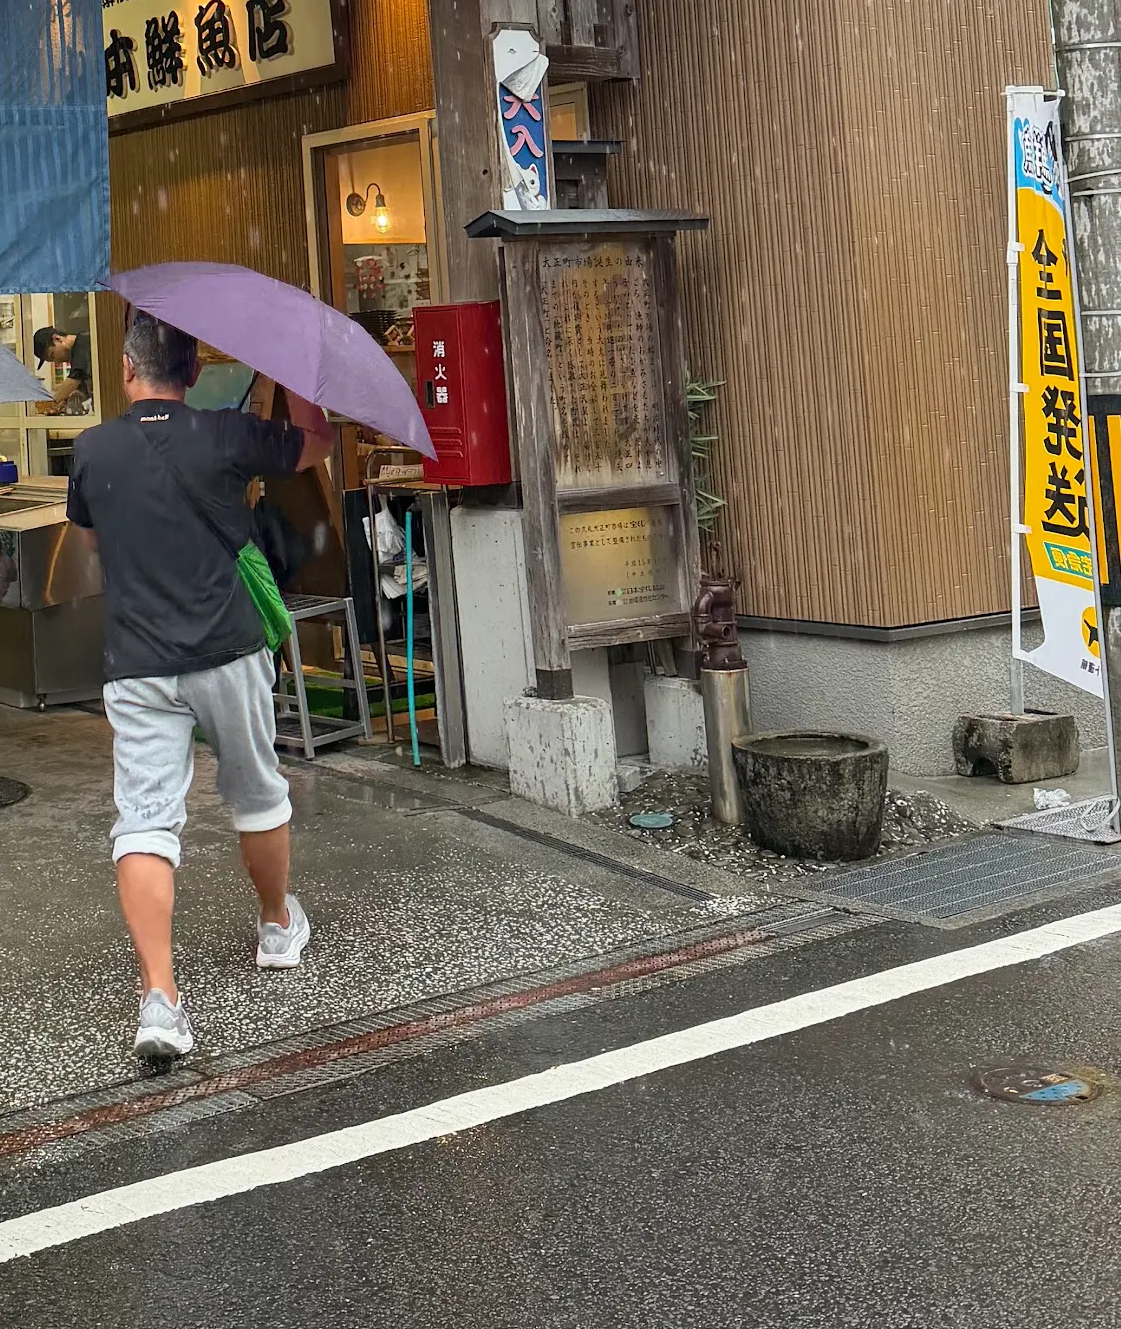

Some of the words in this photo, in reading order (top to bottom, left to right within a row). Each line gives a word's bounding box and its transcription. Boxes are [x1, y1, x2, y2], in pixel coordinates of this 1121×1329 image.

[542, 255, 644, 269] 大正町市場誕生の由来
[433, 340, 449, 404] 消火器
